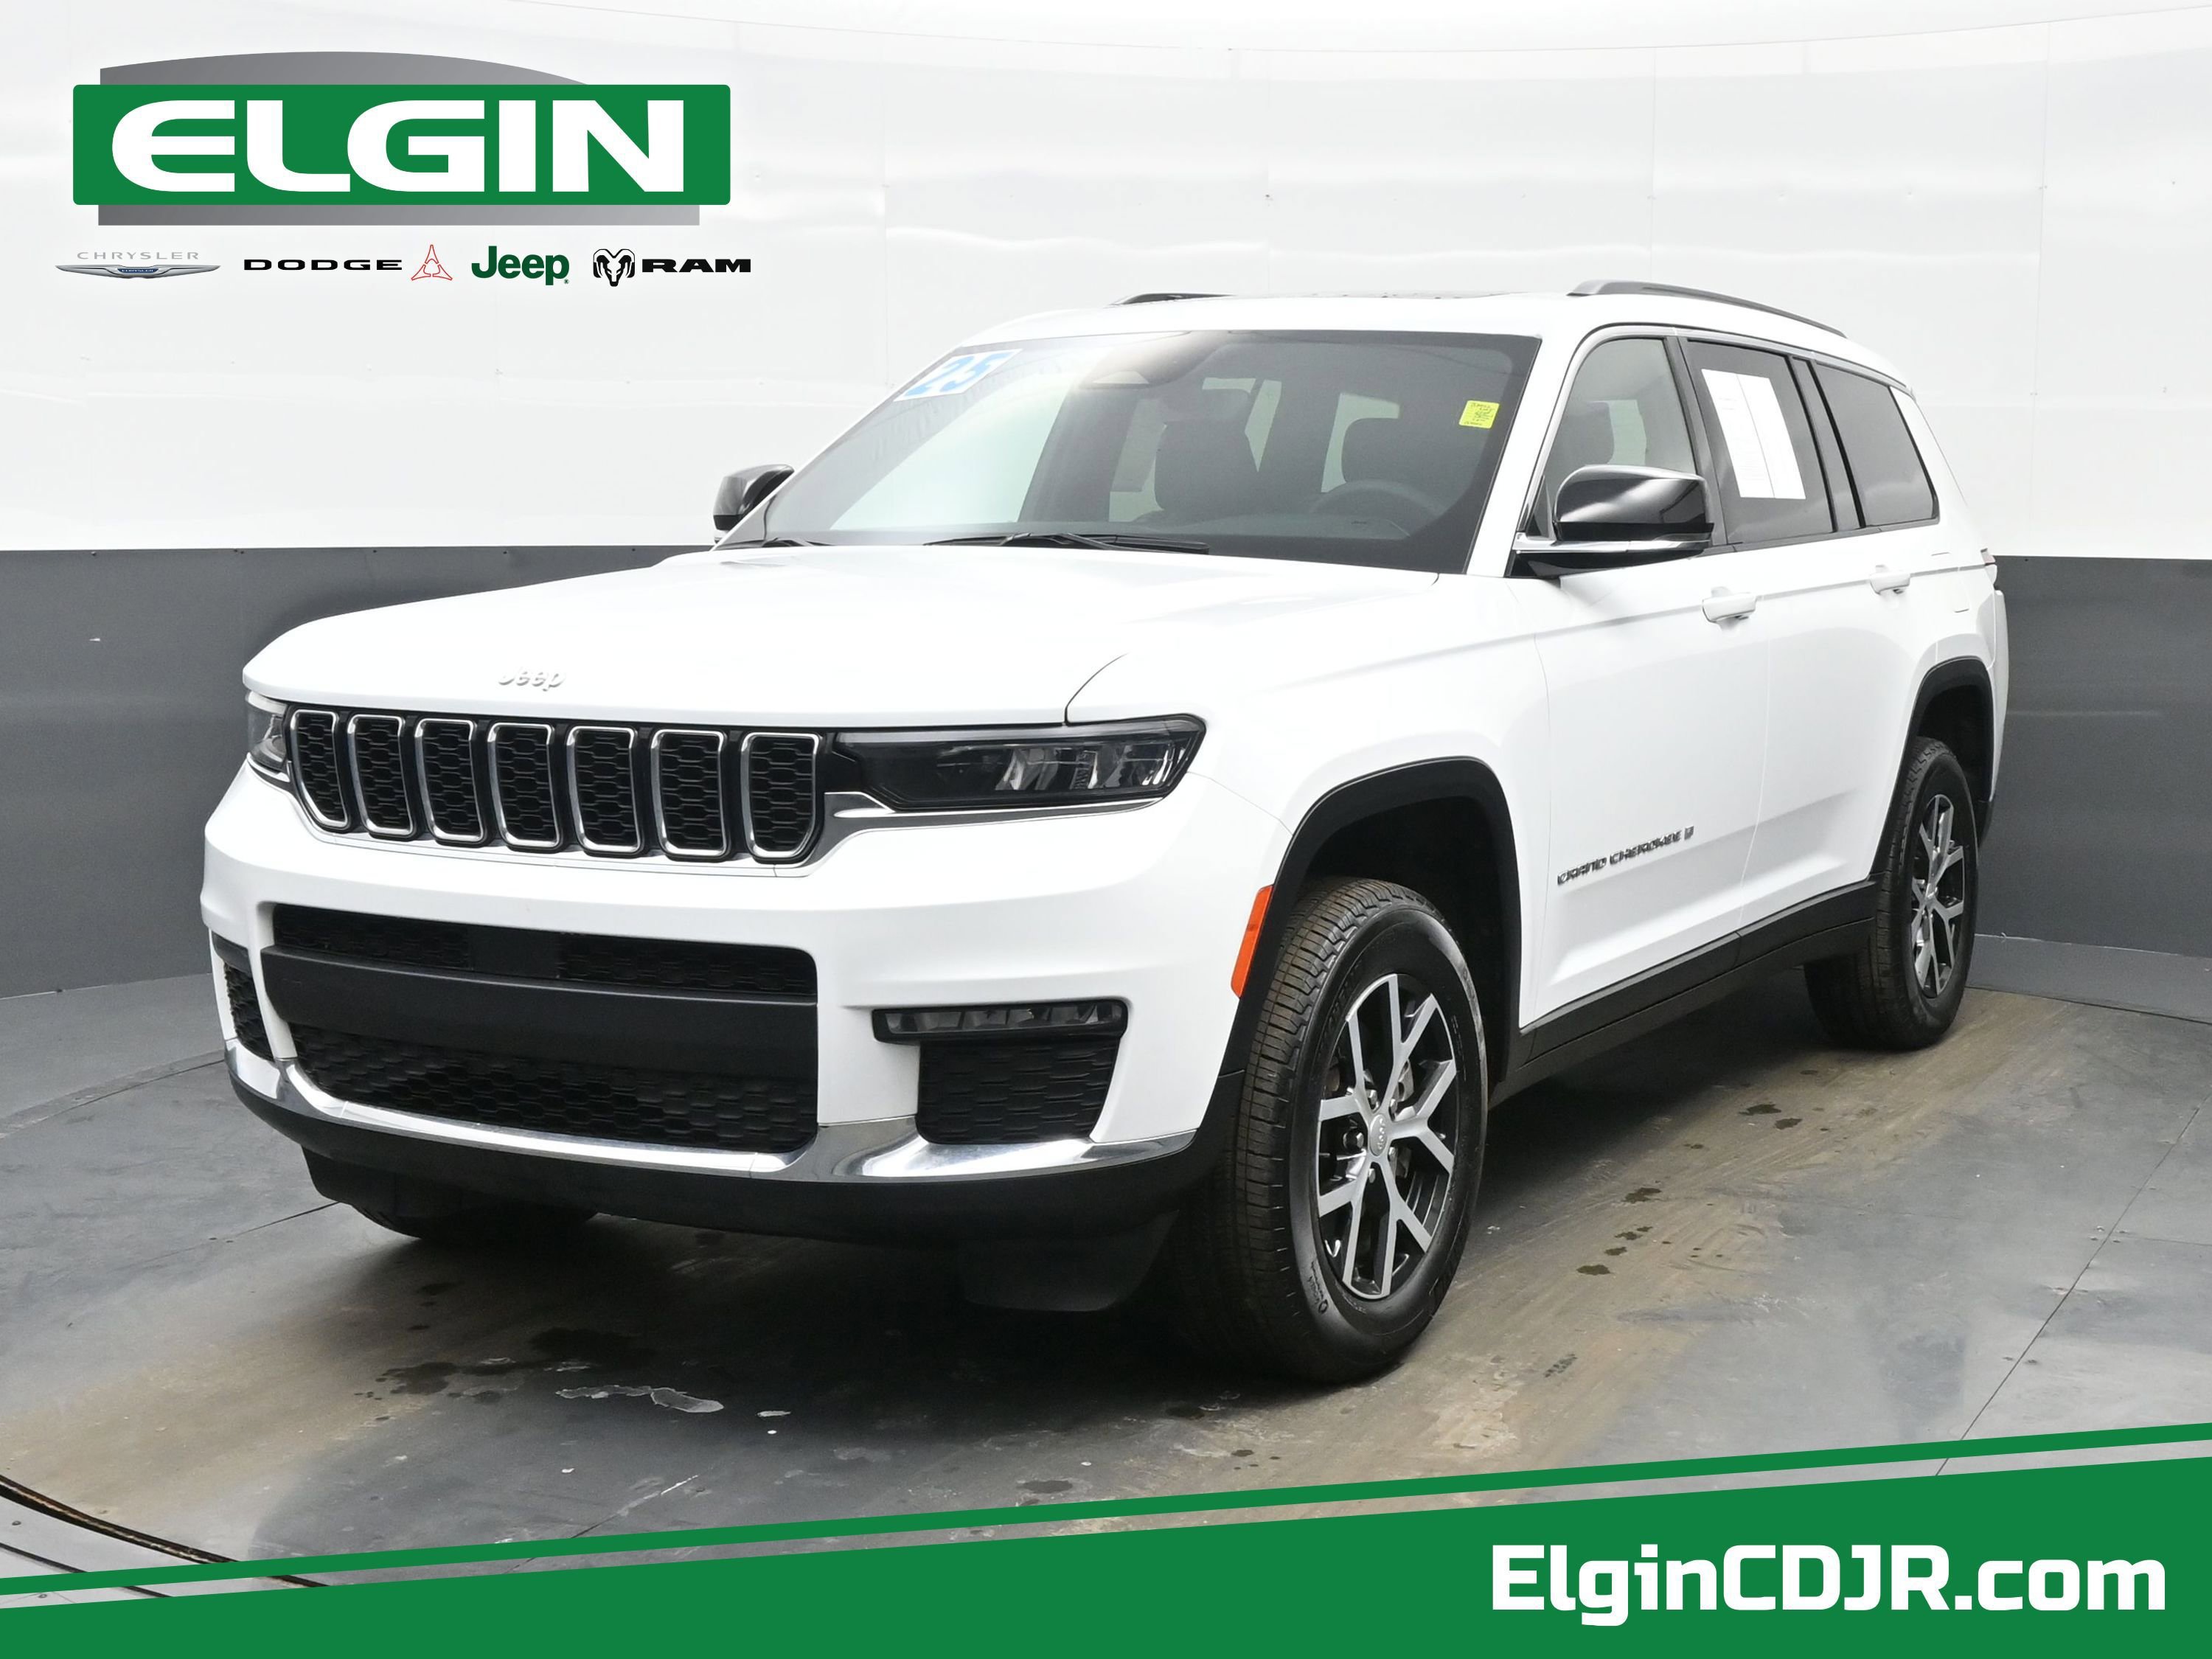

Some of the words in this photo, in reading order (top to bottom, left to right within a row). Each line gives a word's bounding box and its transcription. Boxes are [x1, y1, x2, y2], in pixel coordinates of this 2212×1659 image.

[902, 351, 1015, 397] 25
[497, 666, 567, 692] Jeep
[1557, 857, 1607, 886] GRAND
[1610, 830, 1683, 866] CHEROKEE
